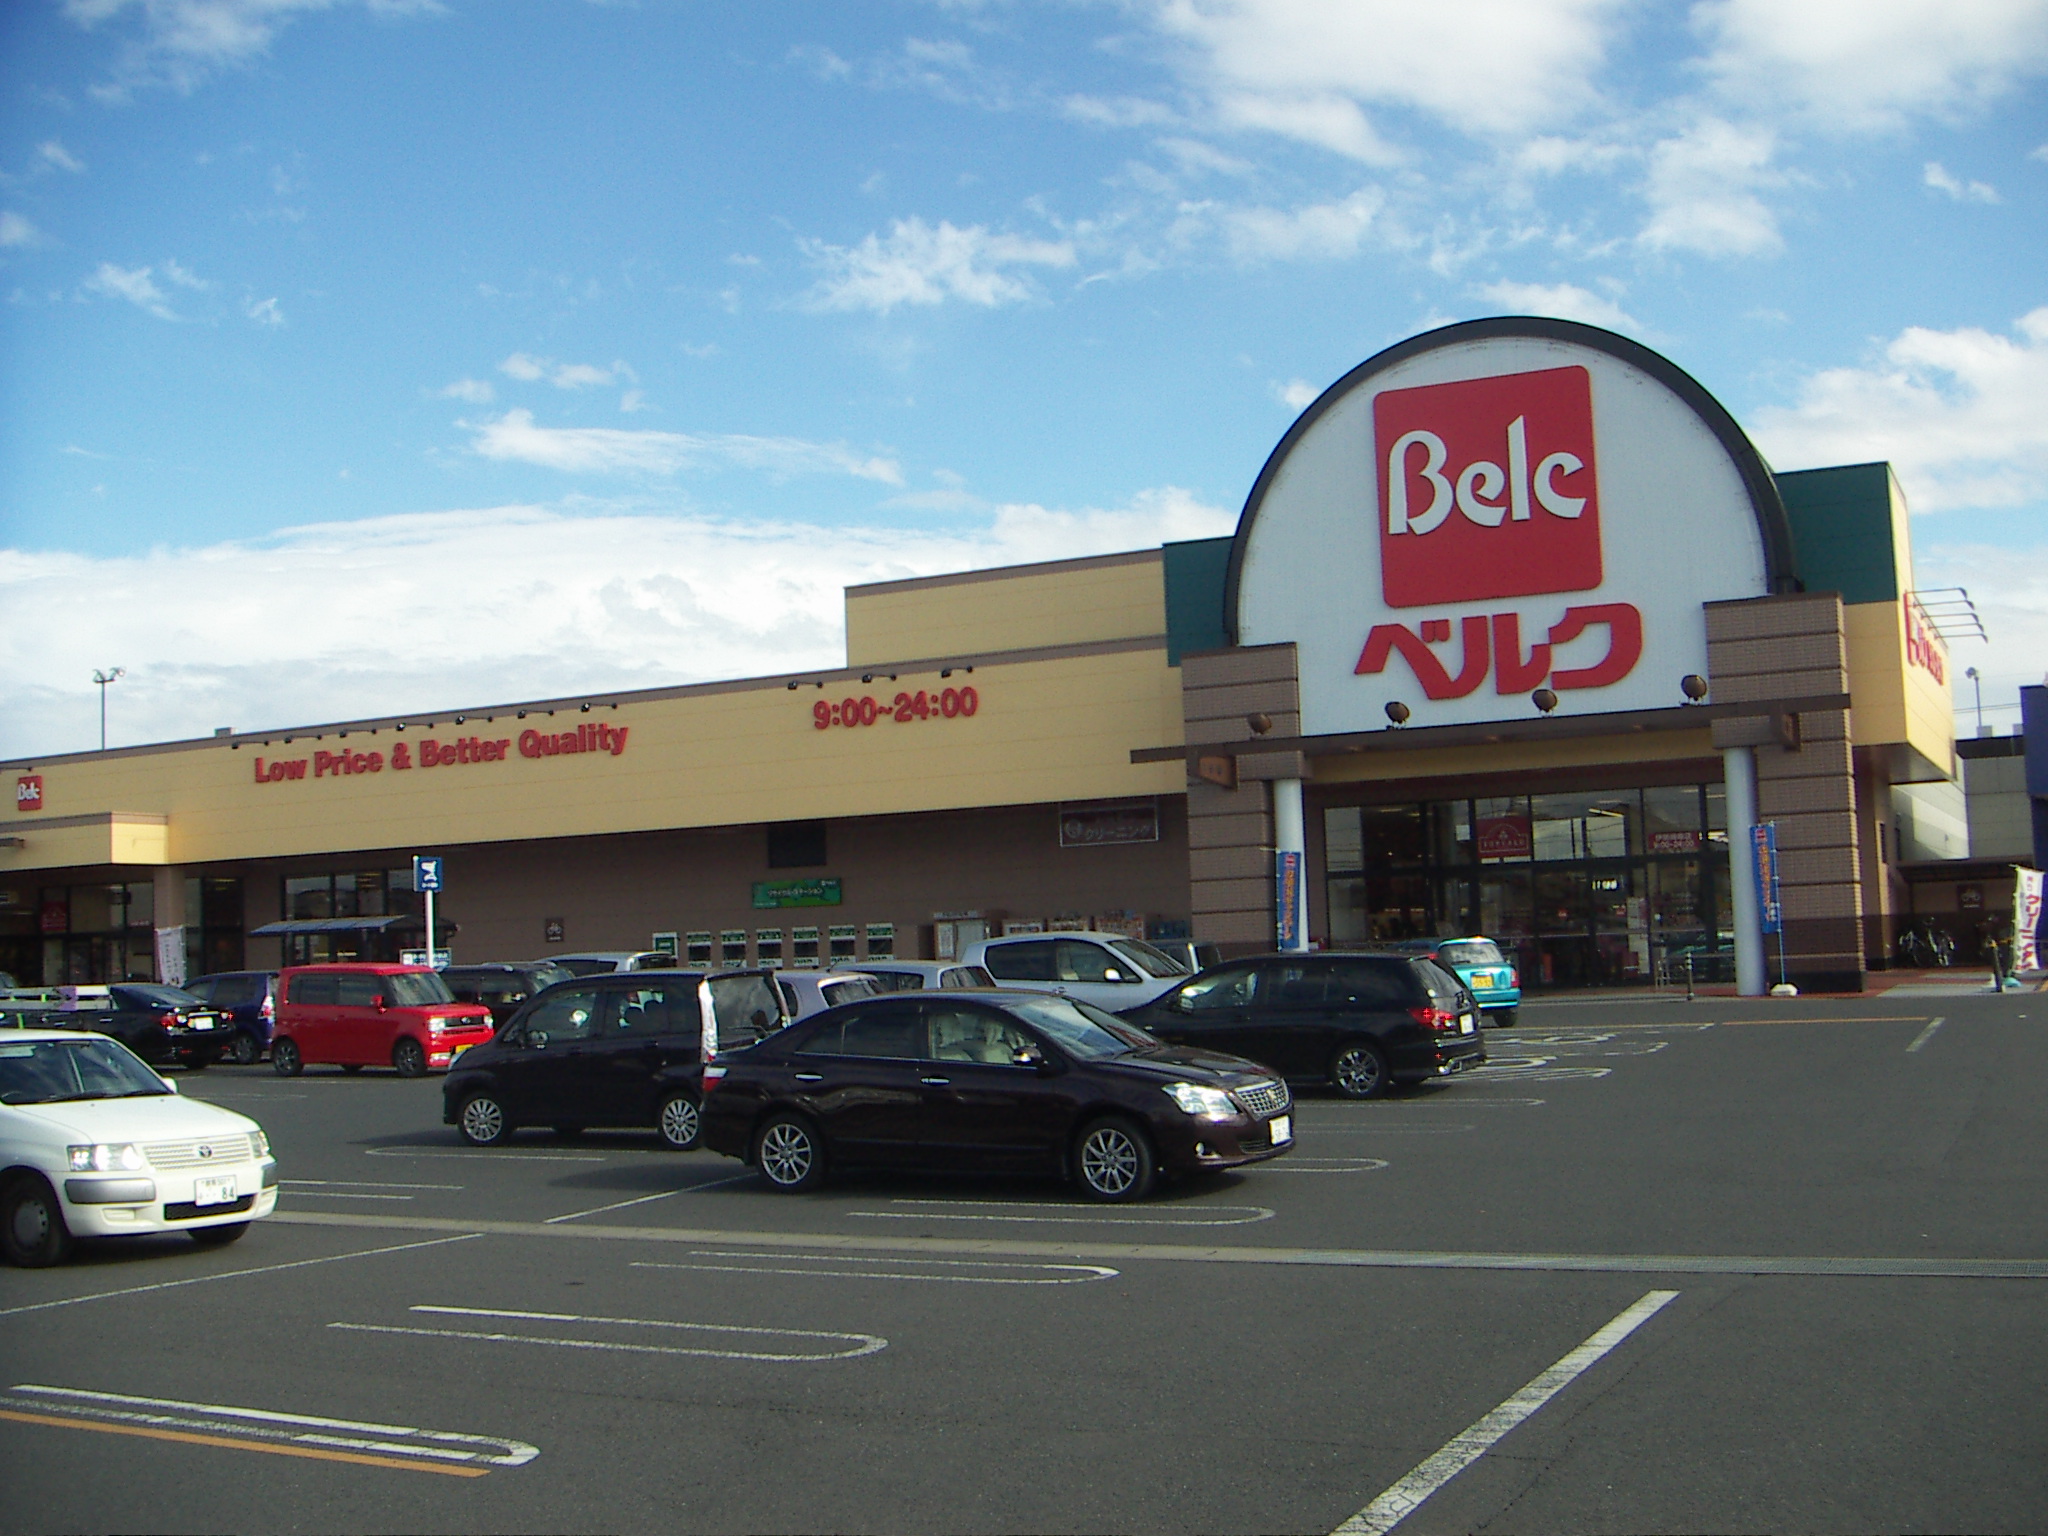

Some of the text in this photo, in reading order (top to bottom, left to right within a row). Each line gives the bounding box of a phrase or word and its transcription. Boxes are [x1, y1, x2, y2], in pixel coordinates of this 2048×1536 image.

[1388, 414, 1588, 536] Belc
[1354, 602, 1643, 701] ベルク
[255, 722, 629, 783] Low Price & Better Quality
